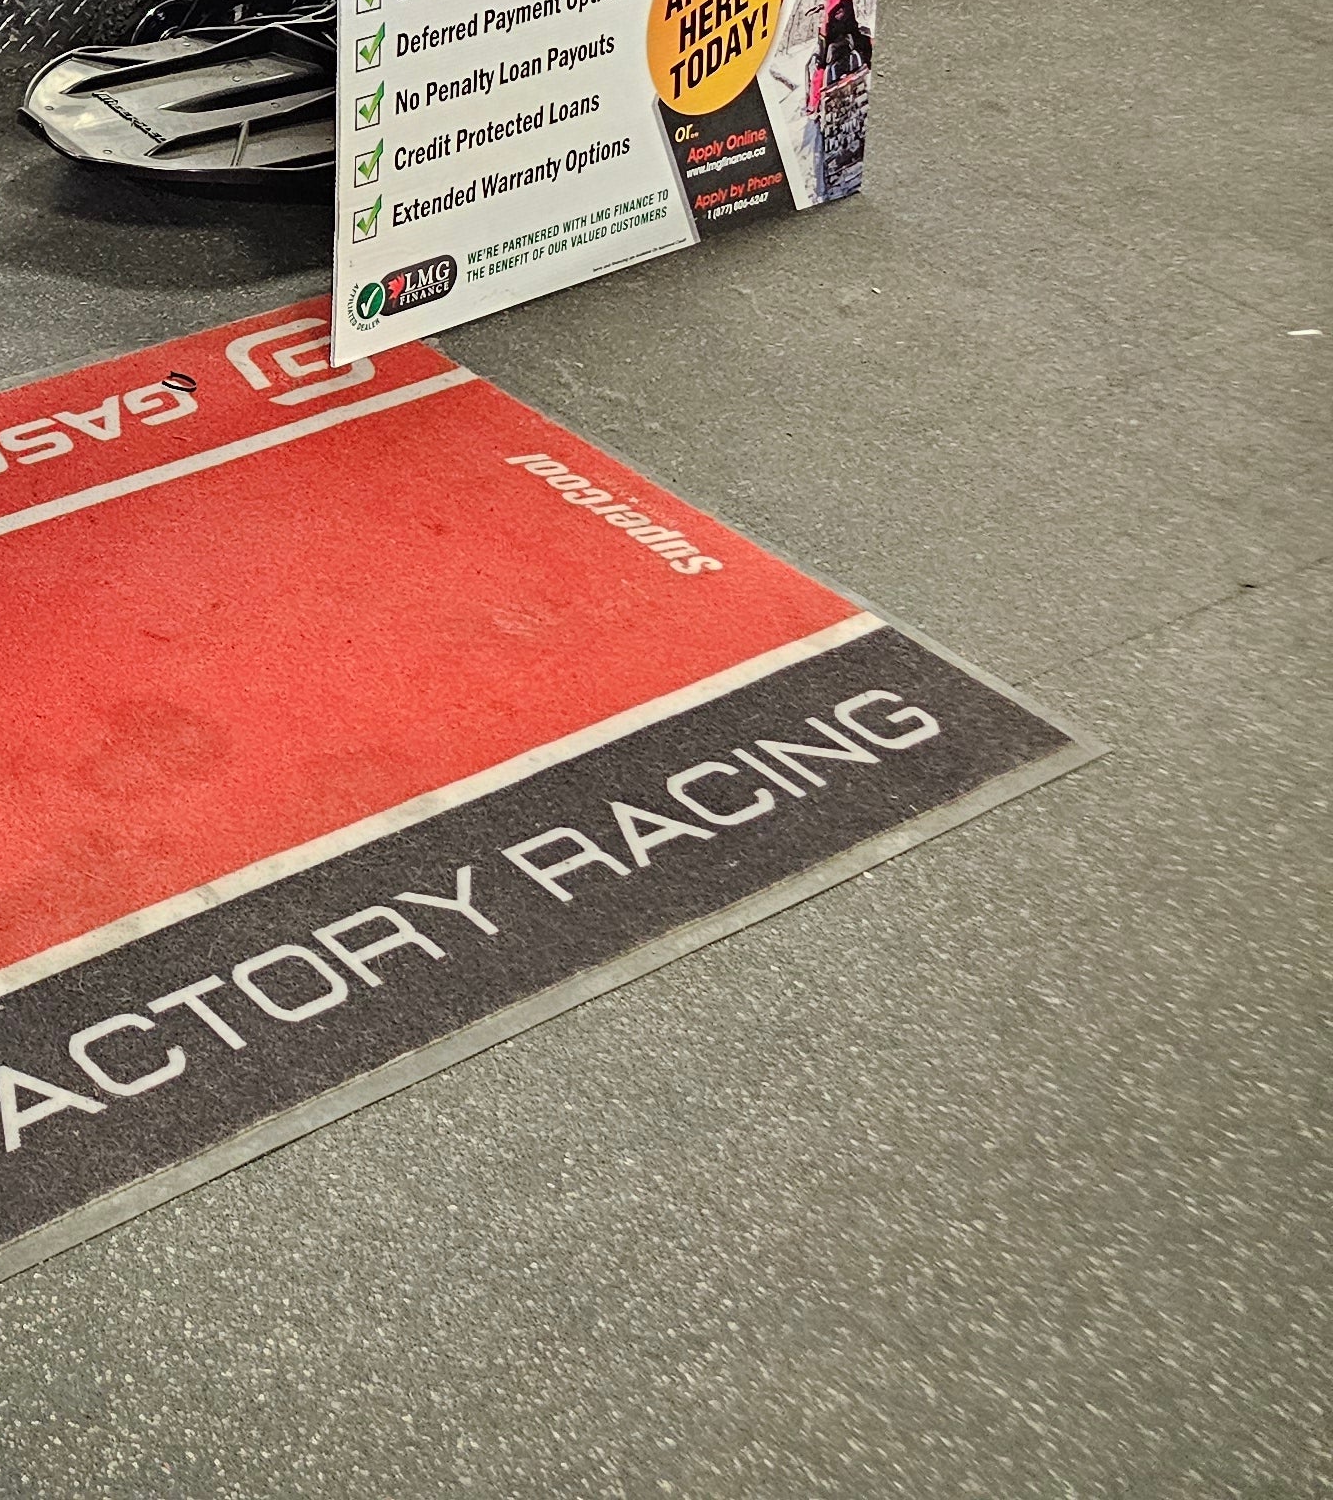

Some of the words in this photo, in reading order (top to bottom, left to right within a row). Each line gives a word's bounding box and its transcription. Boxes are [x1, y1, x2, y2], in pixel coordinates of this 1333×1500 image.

[396, 13, 478, 58] Deferred
[668, 5, 770, 100] TODAY!
[395, 89, 420, 115] No
[426, 68, 495, 107] Penalty
[499, 56, 542, 85] Loan
[547, 34, 616, 71] Payouts
[394, 133, 452, 171] Credit
[456, 105, 544, 152] Protected
[549, 93, 600, 125] Loans
[686, 140, 724, 163] Apply
[726, 127, 767, 151] Online
[686, 146, 766, 179] www.lmgfinance.ca
[392, 180, 476, 227] Extended
[482, 156, 562, 199] Warranty
[565, 137, 631, 173] Options
[694, 187, 728, 210] Apply
[729, 182, 746, 198] by
[746, 171, 784, 192] Phone
[466, 267, 486, 284] THE
[489, 251, 529, 278] BENEFIT
[532, 245, 545, 262] OF
[547, 237, 569, 257] OUR
[571, 223, 608, 251] VALUED
[610, 205, 668, 240] CUSTOMERS
[467, 245, 499, 265] WE'RE
[502, 224, 561, 257] PARTNERED
[563, 215, 588, 237] WITH
[590, 206, 612, 228] LMG
[614, 194, 654, 223] FINANCE
[656, 188, 670, 203] TO
[398, 281, 451, 307] FINANCE
[404, 257, 451, 293] LMG
[346, 282, 360, 328] AFFILIATED
[356, 318, 381, 333] DEALER
[501, 688, 941, 903] RACING
